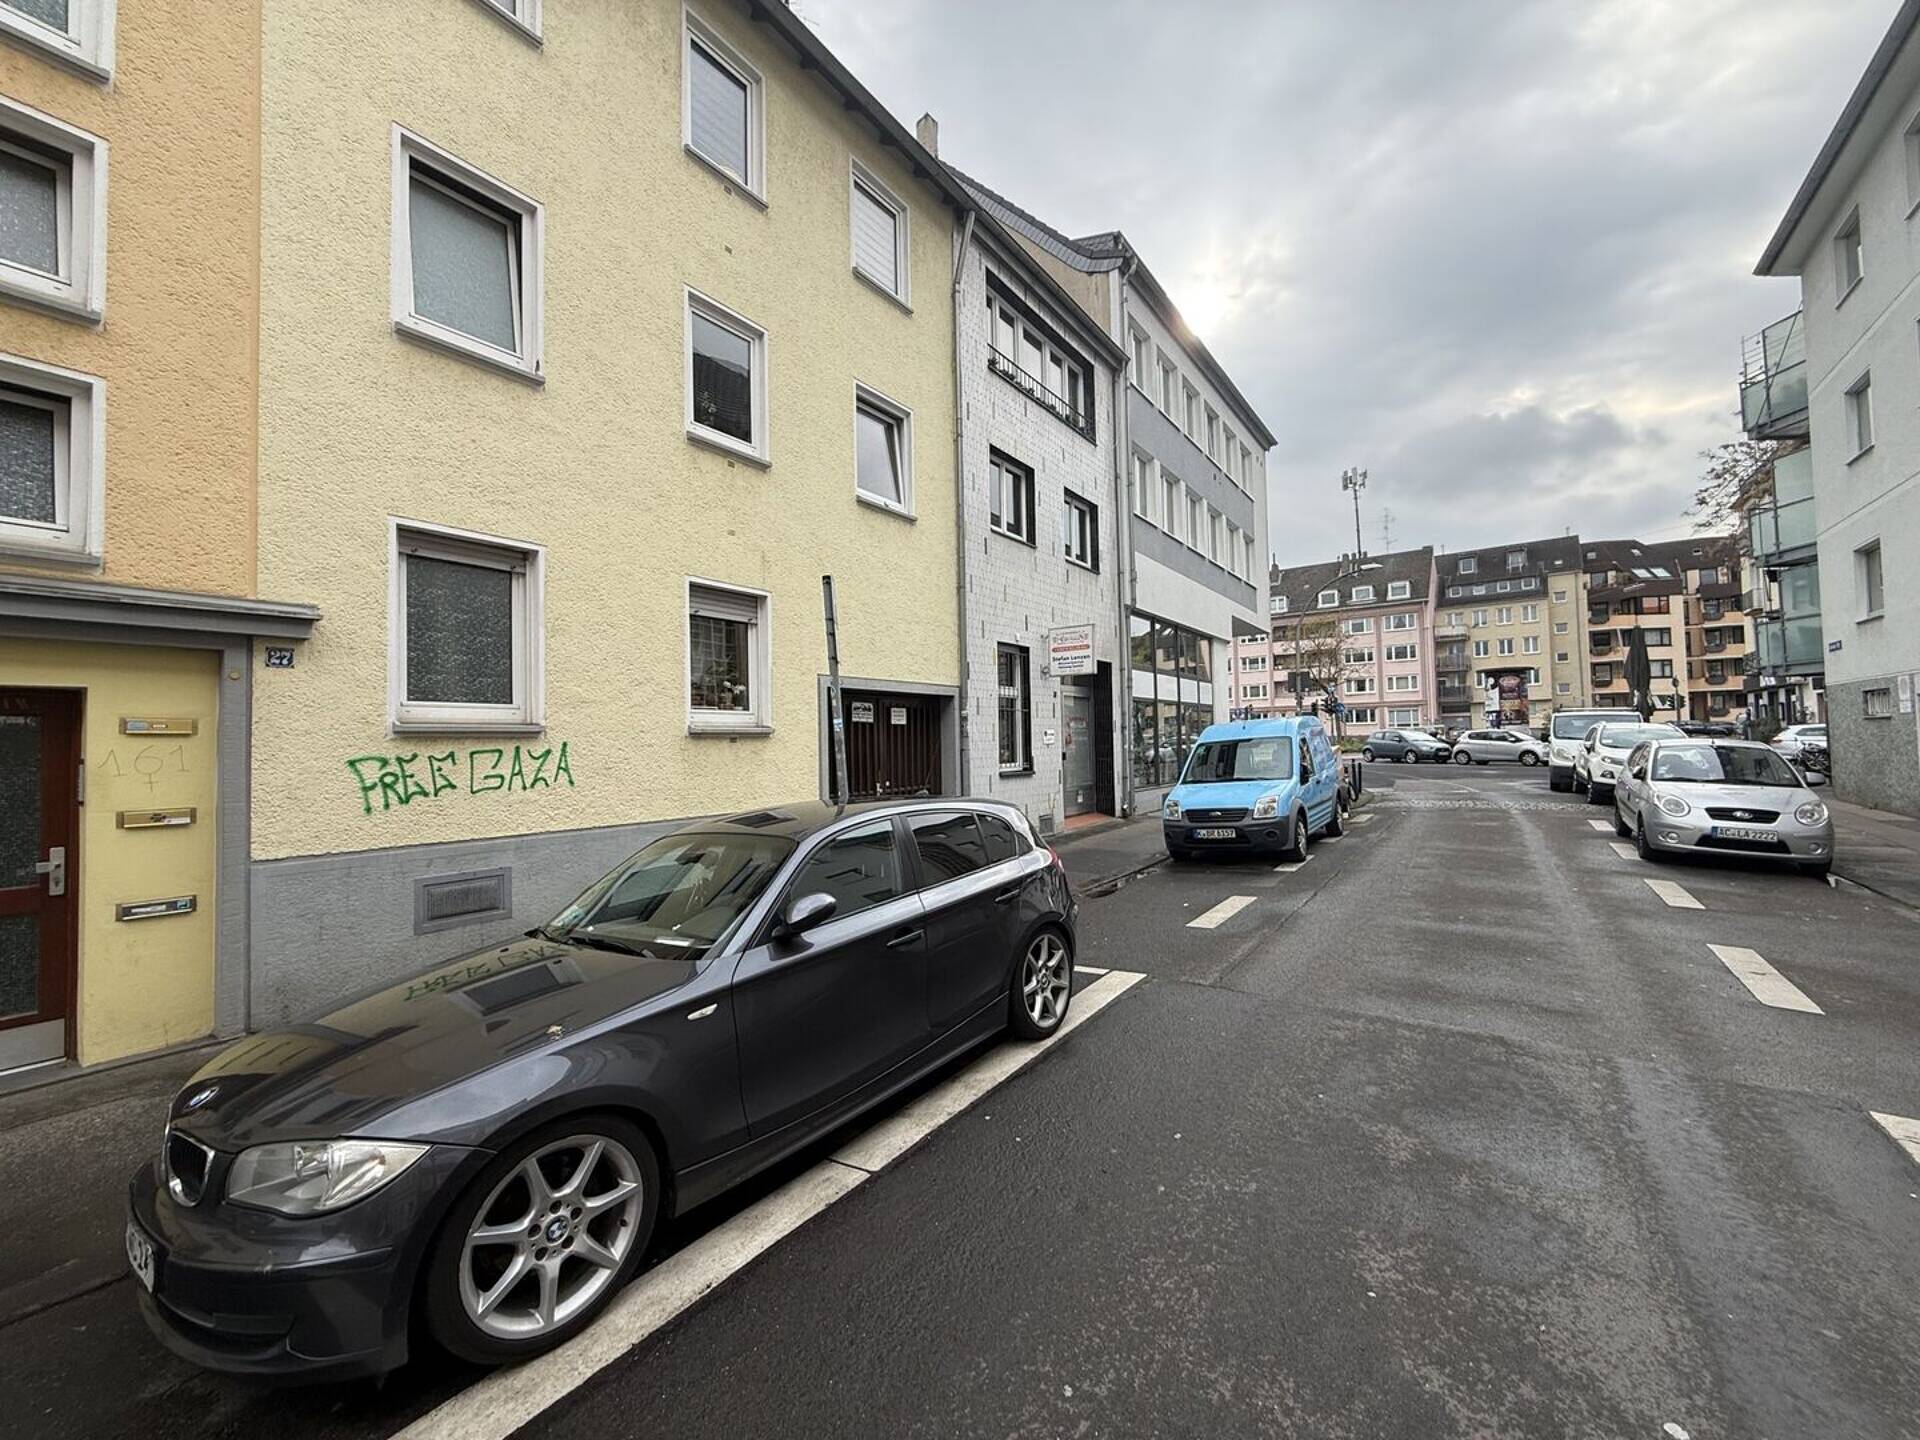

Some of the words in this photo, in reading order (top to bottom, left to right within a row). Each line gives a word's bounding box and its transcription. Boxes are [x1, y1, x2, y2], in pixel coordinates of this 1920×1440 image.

[270, 649, 291, 665] 27
[346, 751, 457, 814] FREE
[469, 741, 575, 794] GAZA
